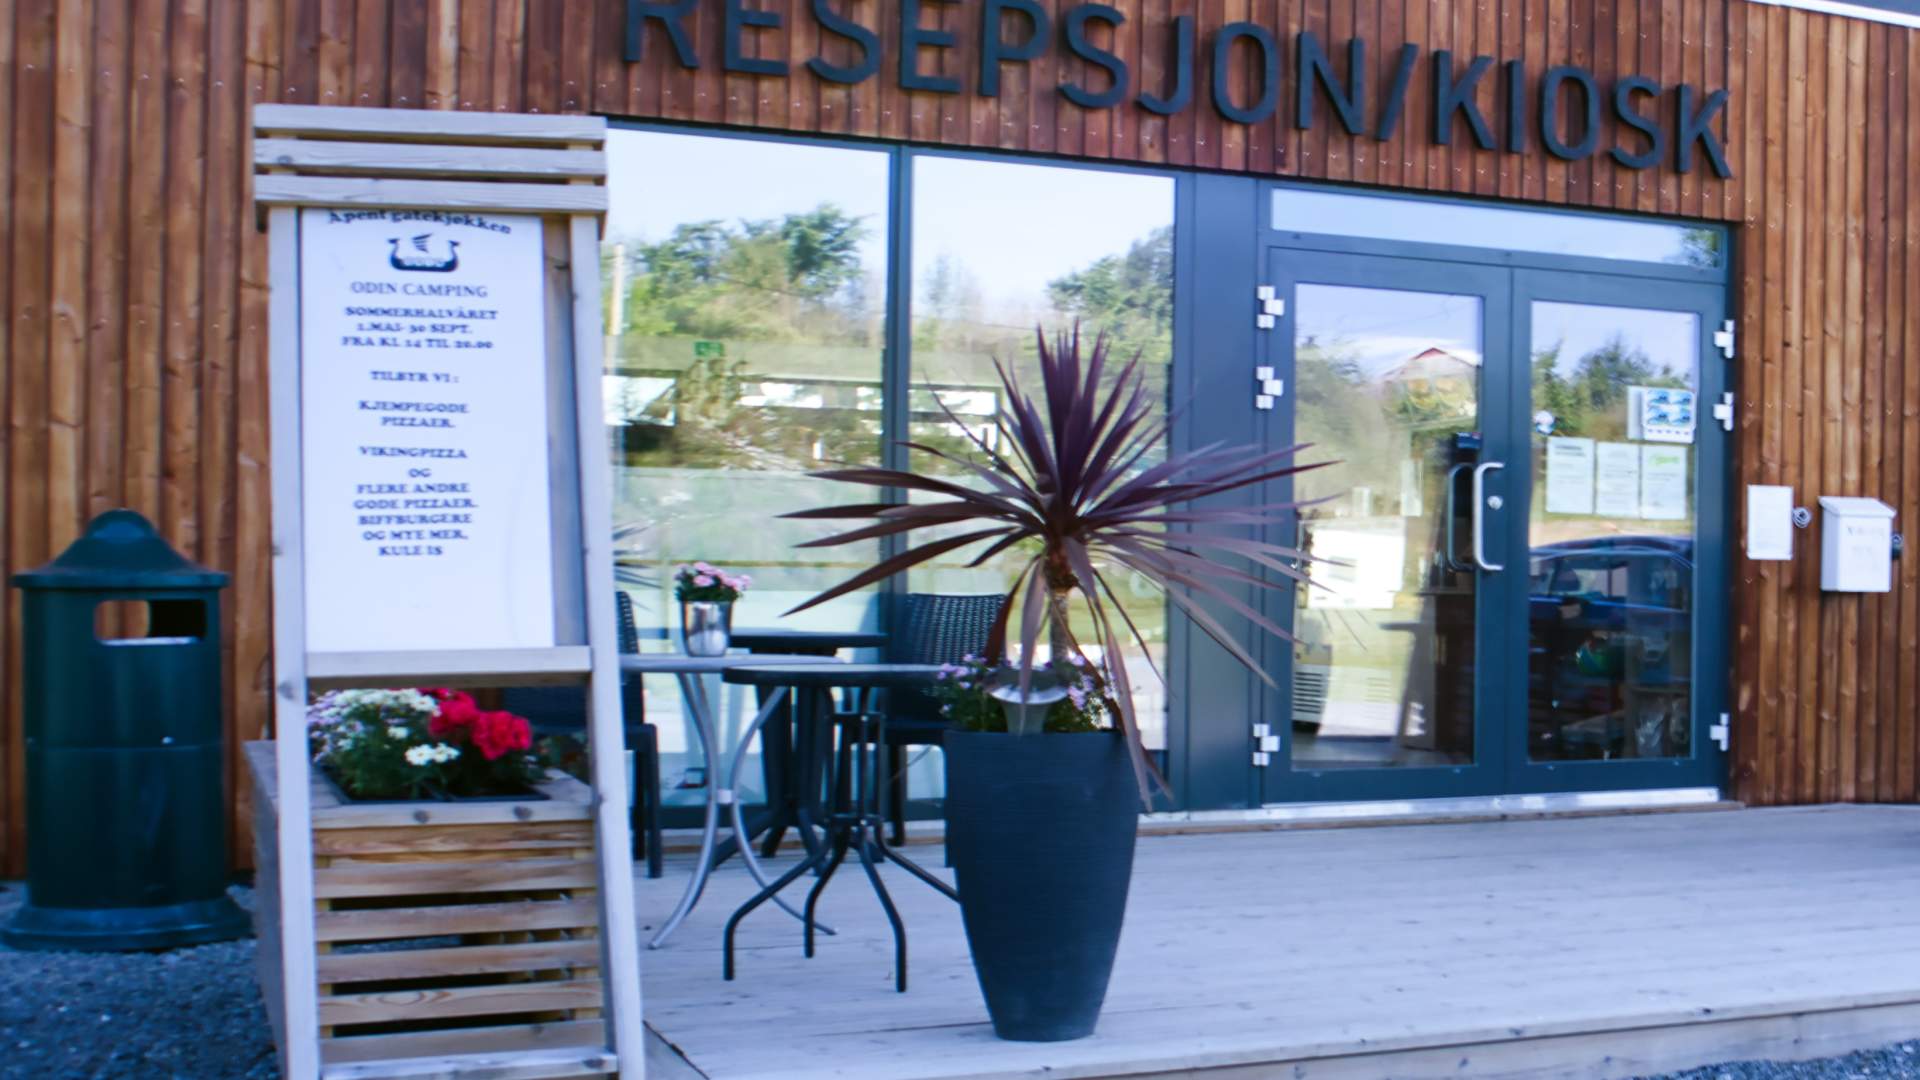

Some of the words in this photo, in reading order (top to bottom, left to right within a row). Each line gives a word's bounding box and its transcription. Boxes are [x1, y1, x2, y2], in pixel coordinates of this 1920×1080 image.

[620, 0, 1733, 180] RESEPSJON/KIOSK
[351, 281, 397, 295] ODIN
[402, 282, 488, 298] CAMPING
[345, 306, 498, 320] SOMMERHALVÅRET
[342, 336, 375, 347] FRA
[426, 338, 449, 349] TIL
[370, 370, 429, 382] TILBYR
[358, 400, 469, 413] KJEMPEGODE
[359, 446, 468, 459] VIKINGPIZZA
[408, 468, 432, 478] OG
[357, 484, 407, 494] FLERE
[413, 483, 471, 493] ANDRE
[354, 500, 399, 509] GODE
[358, 514, 472, 525] BIFFBURGERE
[363, 531, 386, 540] OG
[390, 531, 425, 540] MYE
[379, 546, 423, 556] KULE
[428, 546, 443, 556] IS
